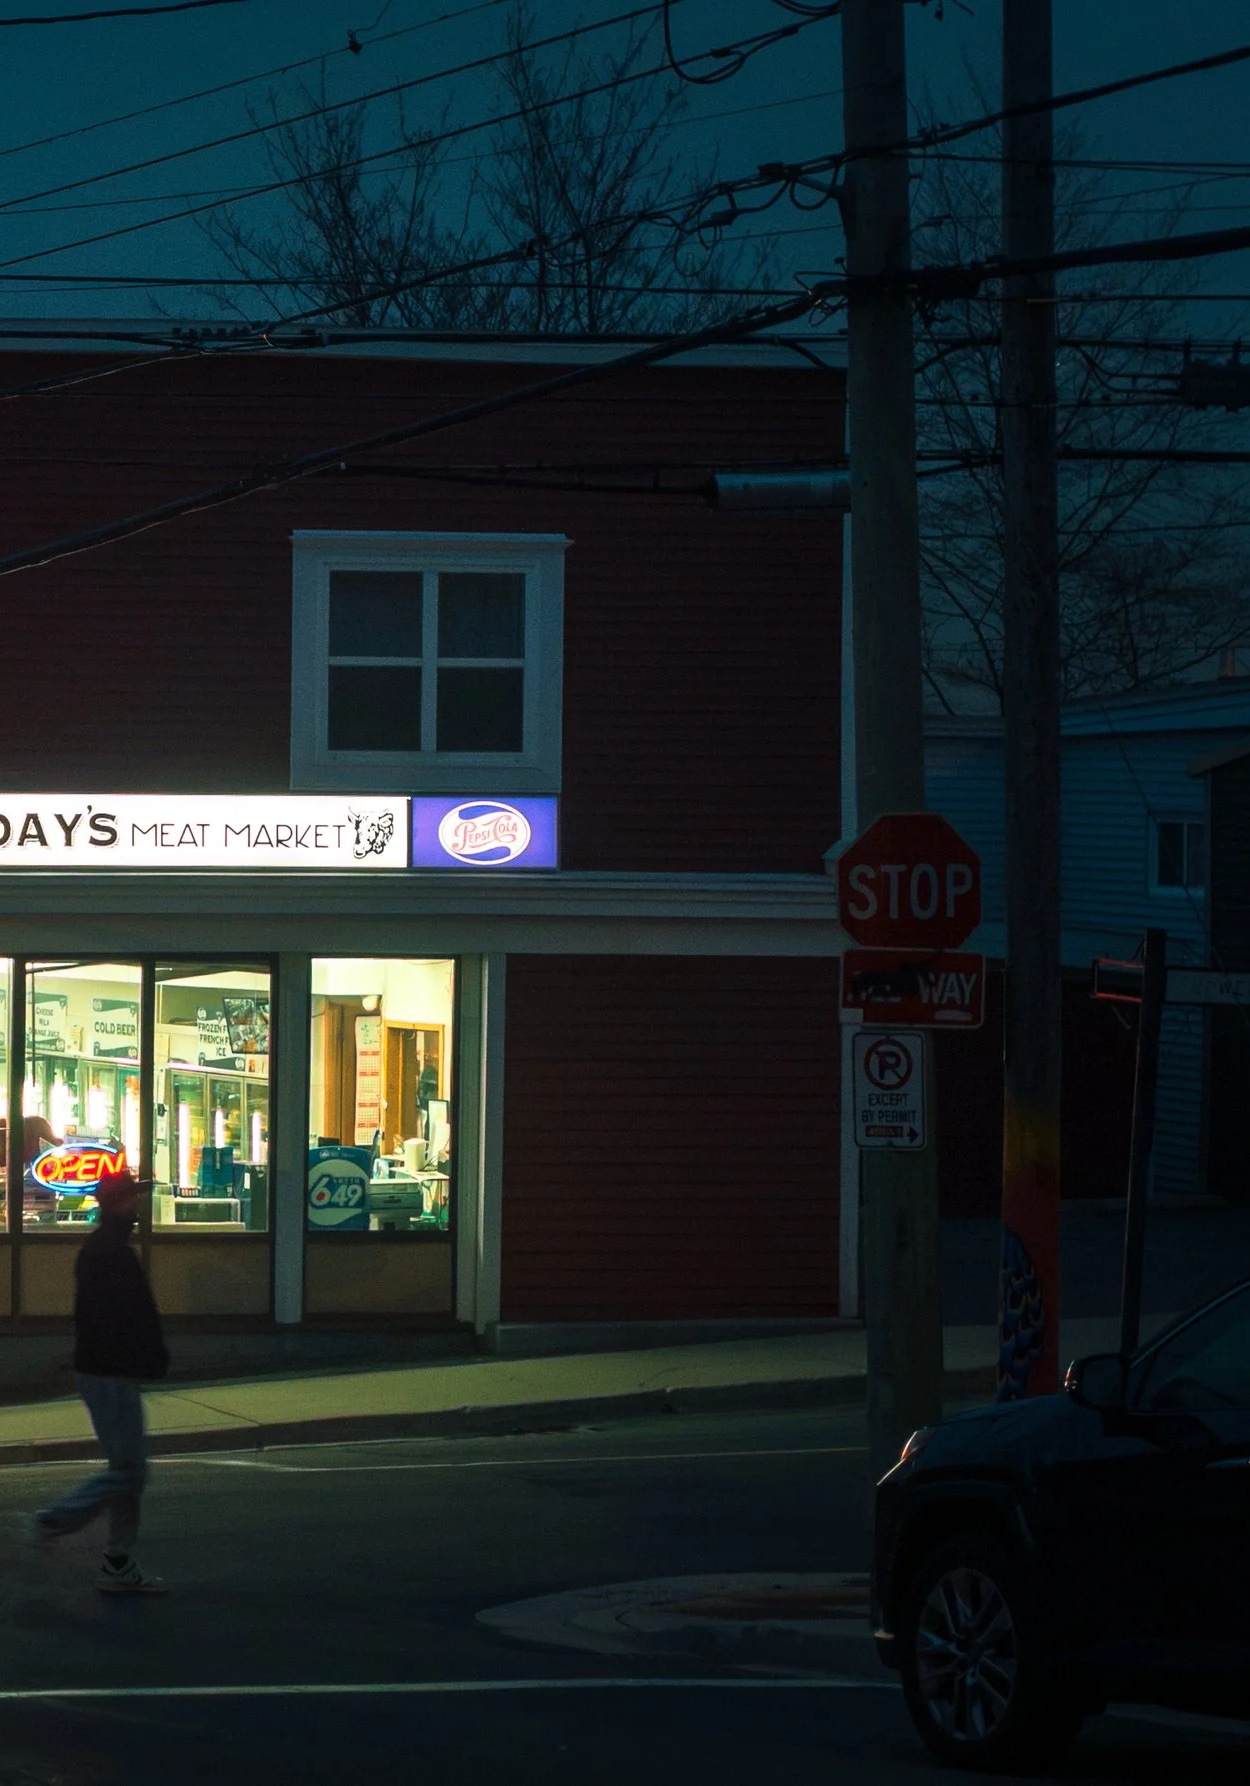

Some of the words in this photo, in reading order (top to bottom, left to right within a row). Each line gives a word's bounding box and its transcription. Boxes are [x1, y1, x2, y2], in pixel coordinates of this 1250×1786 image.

[132, 823, 210, 847] MEAT
[224, 824, 346, 848] MARKET
[848, 863, 974, 920] STOP
[916, 971, 977, 1004] WAY
[94, 1021, 115, 1034] COLD
[117, 1023, 135, 1036] BEER
[198, 1022, 222, 1033] FROZEN
[199, 1034, 224, 1045] FRENCH
[215, 1047, 226, 1056] ICE
[868, 1093, 909, 1106] EXCEPT
[862, 1109, 874, 1123] BY
[877, 1110, 917, 1123] PERMIT
[37, 1151, 124, 1182] OPEN
